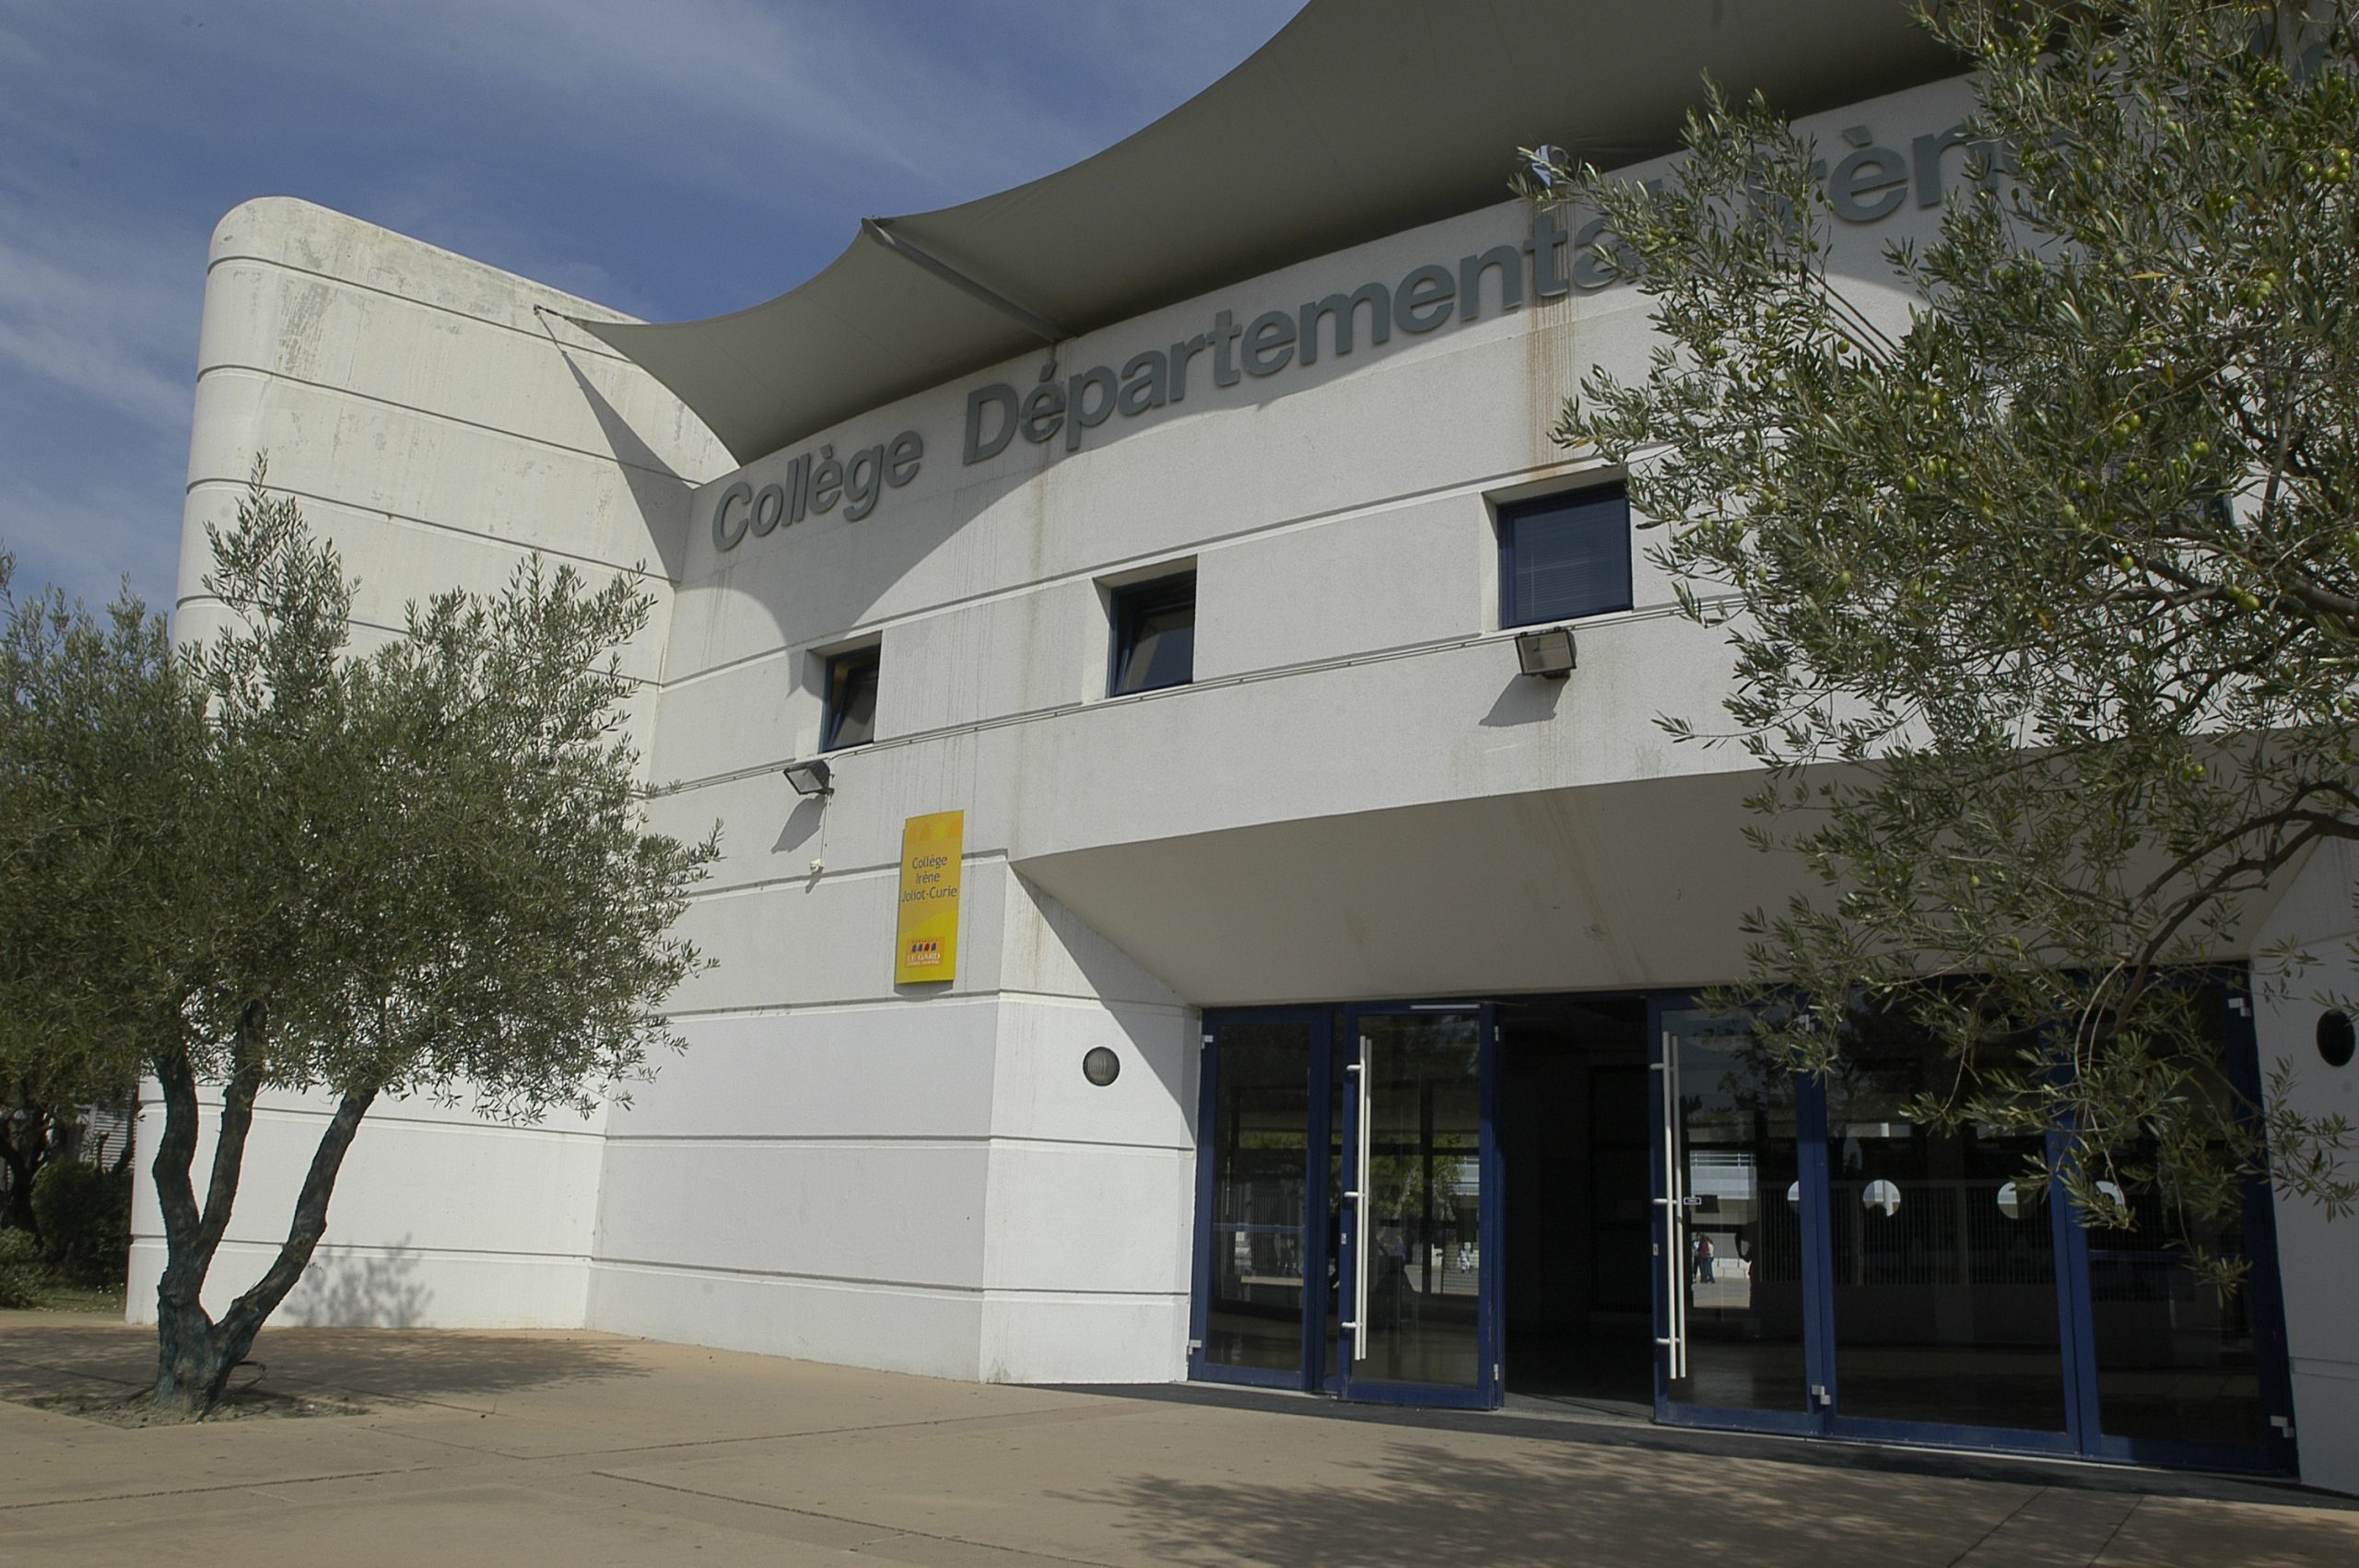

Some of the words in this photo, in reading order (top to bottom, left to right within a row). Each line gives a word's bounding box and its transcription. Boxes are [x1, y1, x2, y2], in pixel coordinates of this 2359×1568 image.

[712, 444, 922, 552] Collège
[962, 178, 1662, 465] Départementa
[912, 854, 948, 869] Collège
[916, 871, 940, 884] Irène
[901, 884, 957, 902] Joliot-Curie
